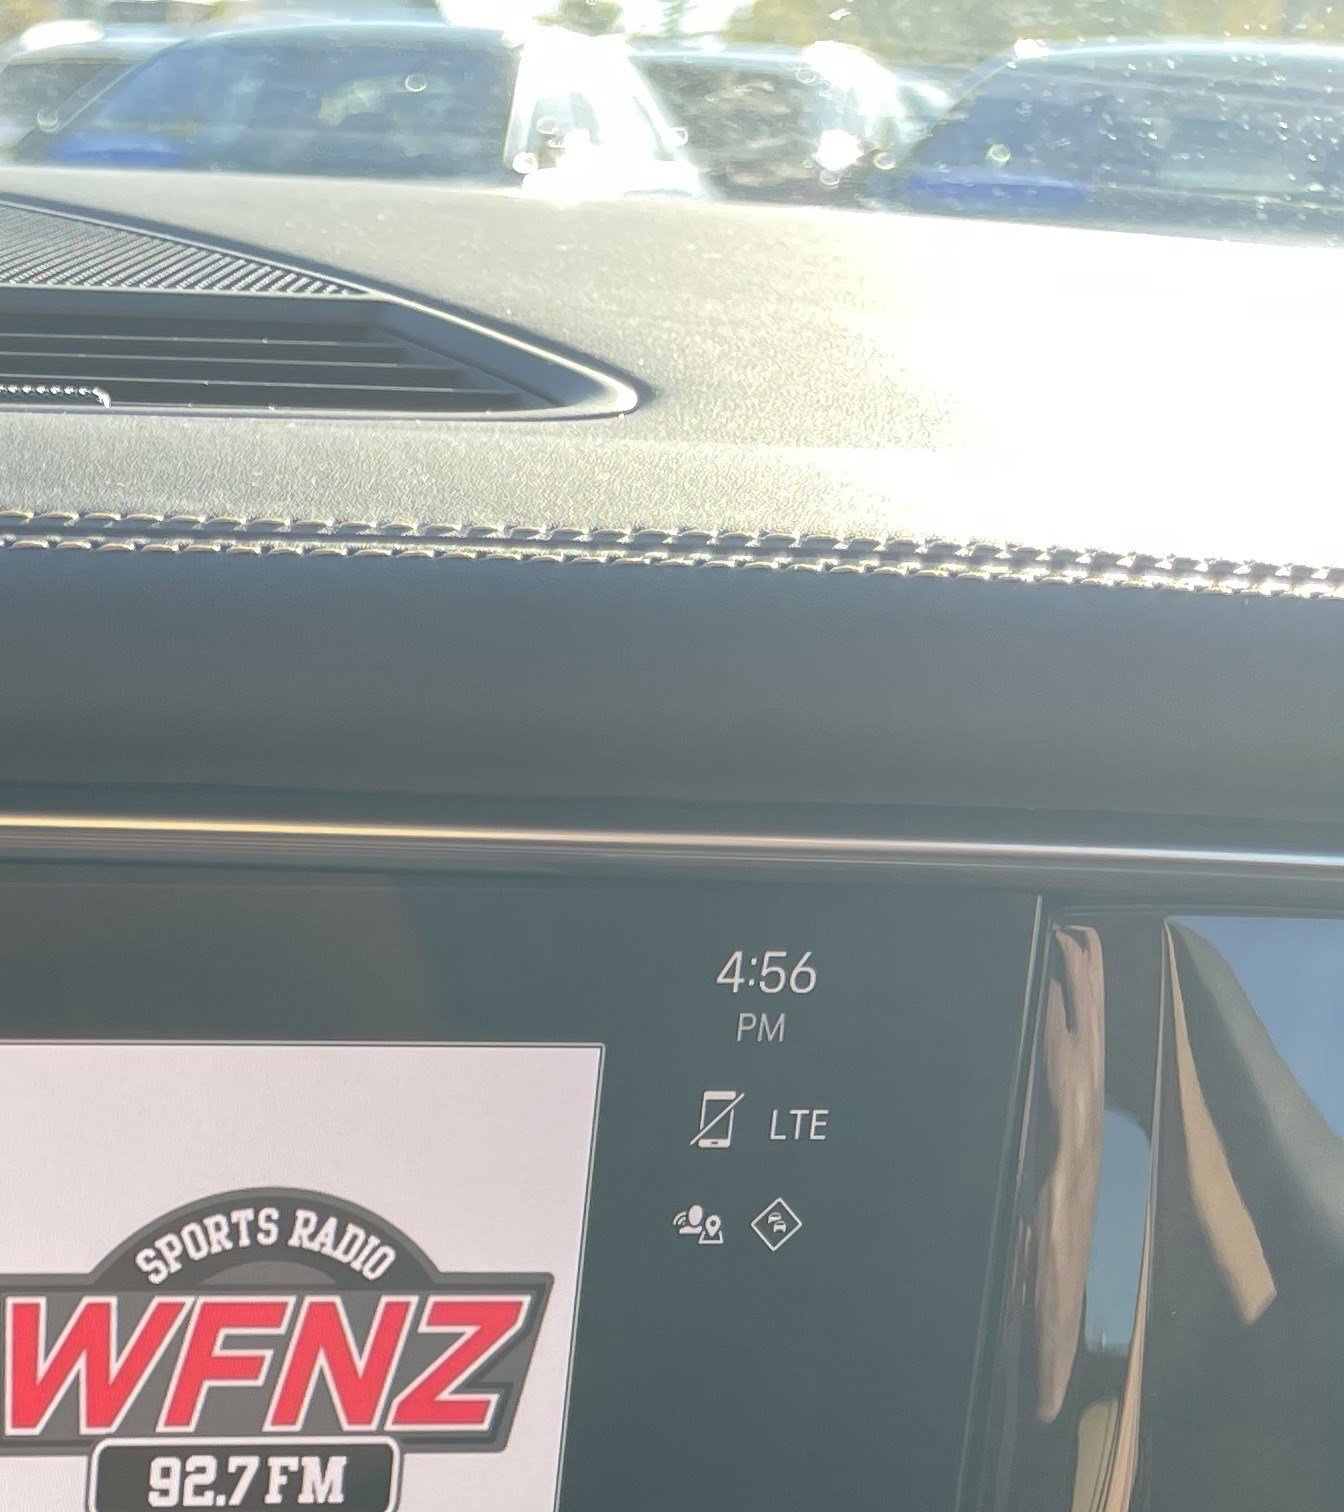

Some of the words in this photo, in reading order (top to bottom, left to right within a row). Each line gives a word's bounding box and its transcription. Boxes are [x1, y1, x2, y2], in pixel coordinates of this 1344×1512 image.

[716, 950, 817, 994] 4:56
[736, 1013, 786, 1042] PM
[769, 1109, 829, 1141] LTE
[135, 1206, 280, 1285] SPORTS
[287, 1208, 397, 1282] RADIO
[5, 1295, 531, 1436] WFNZ
[148, 1456, 261, 1508] 92.7
[264, 1456, 347, 1504] FM
